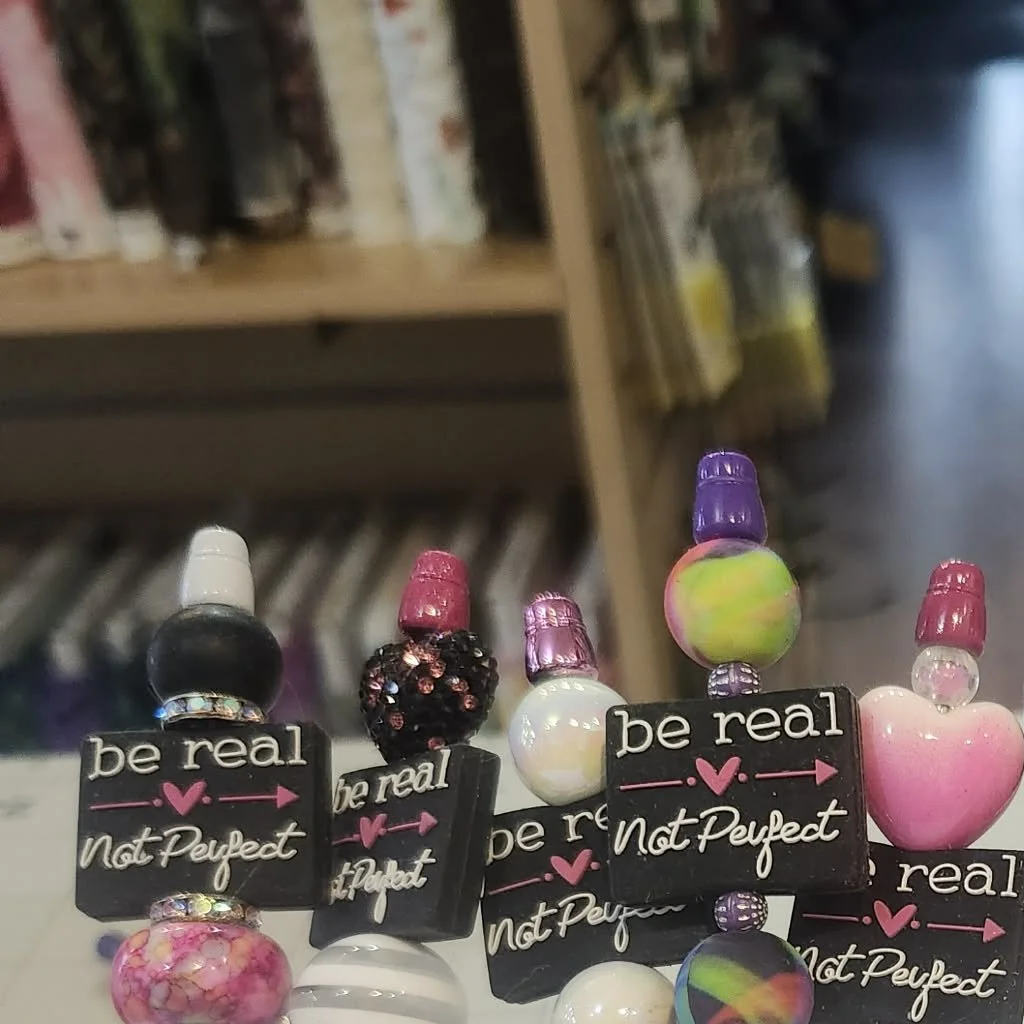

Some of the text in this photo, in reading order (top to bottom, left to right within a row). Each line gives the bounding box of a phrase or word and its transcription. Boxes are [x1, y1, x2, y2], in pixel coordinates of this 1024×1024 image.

[87, 726, 307, 781] be real
[615, 692, 843, 758] be real
[333, 749, 451, 815] be real
[80, 821, 307, 892] Not Perfect
[614, 808, 698, 855] Not
[698, 800, 847, 879] Perfect
[348, 848, 437, 925] Perfect
[896, 855, 1019, 898] real
[488, 902, 557, 956] Not
[861, 947, 1006, 1023] Perfect
